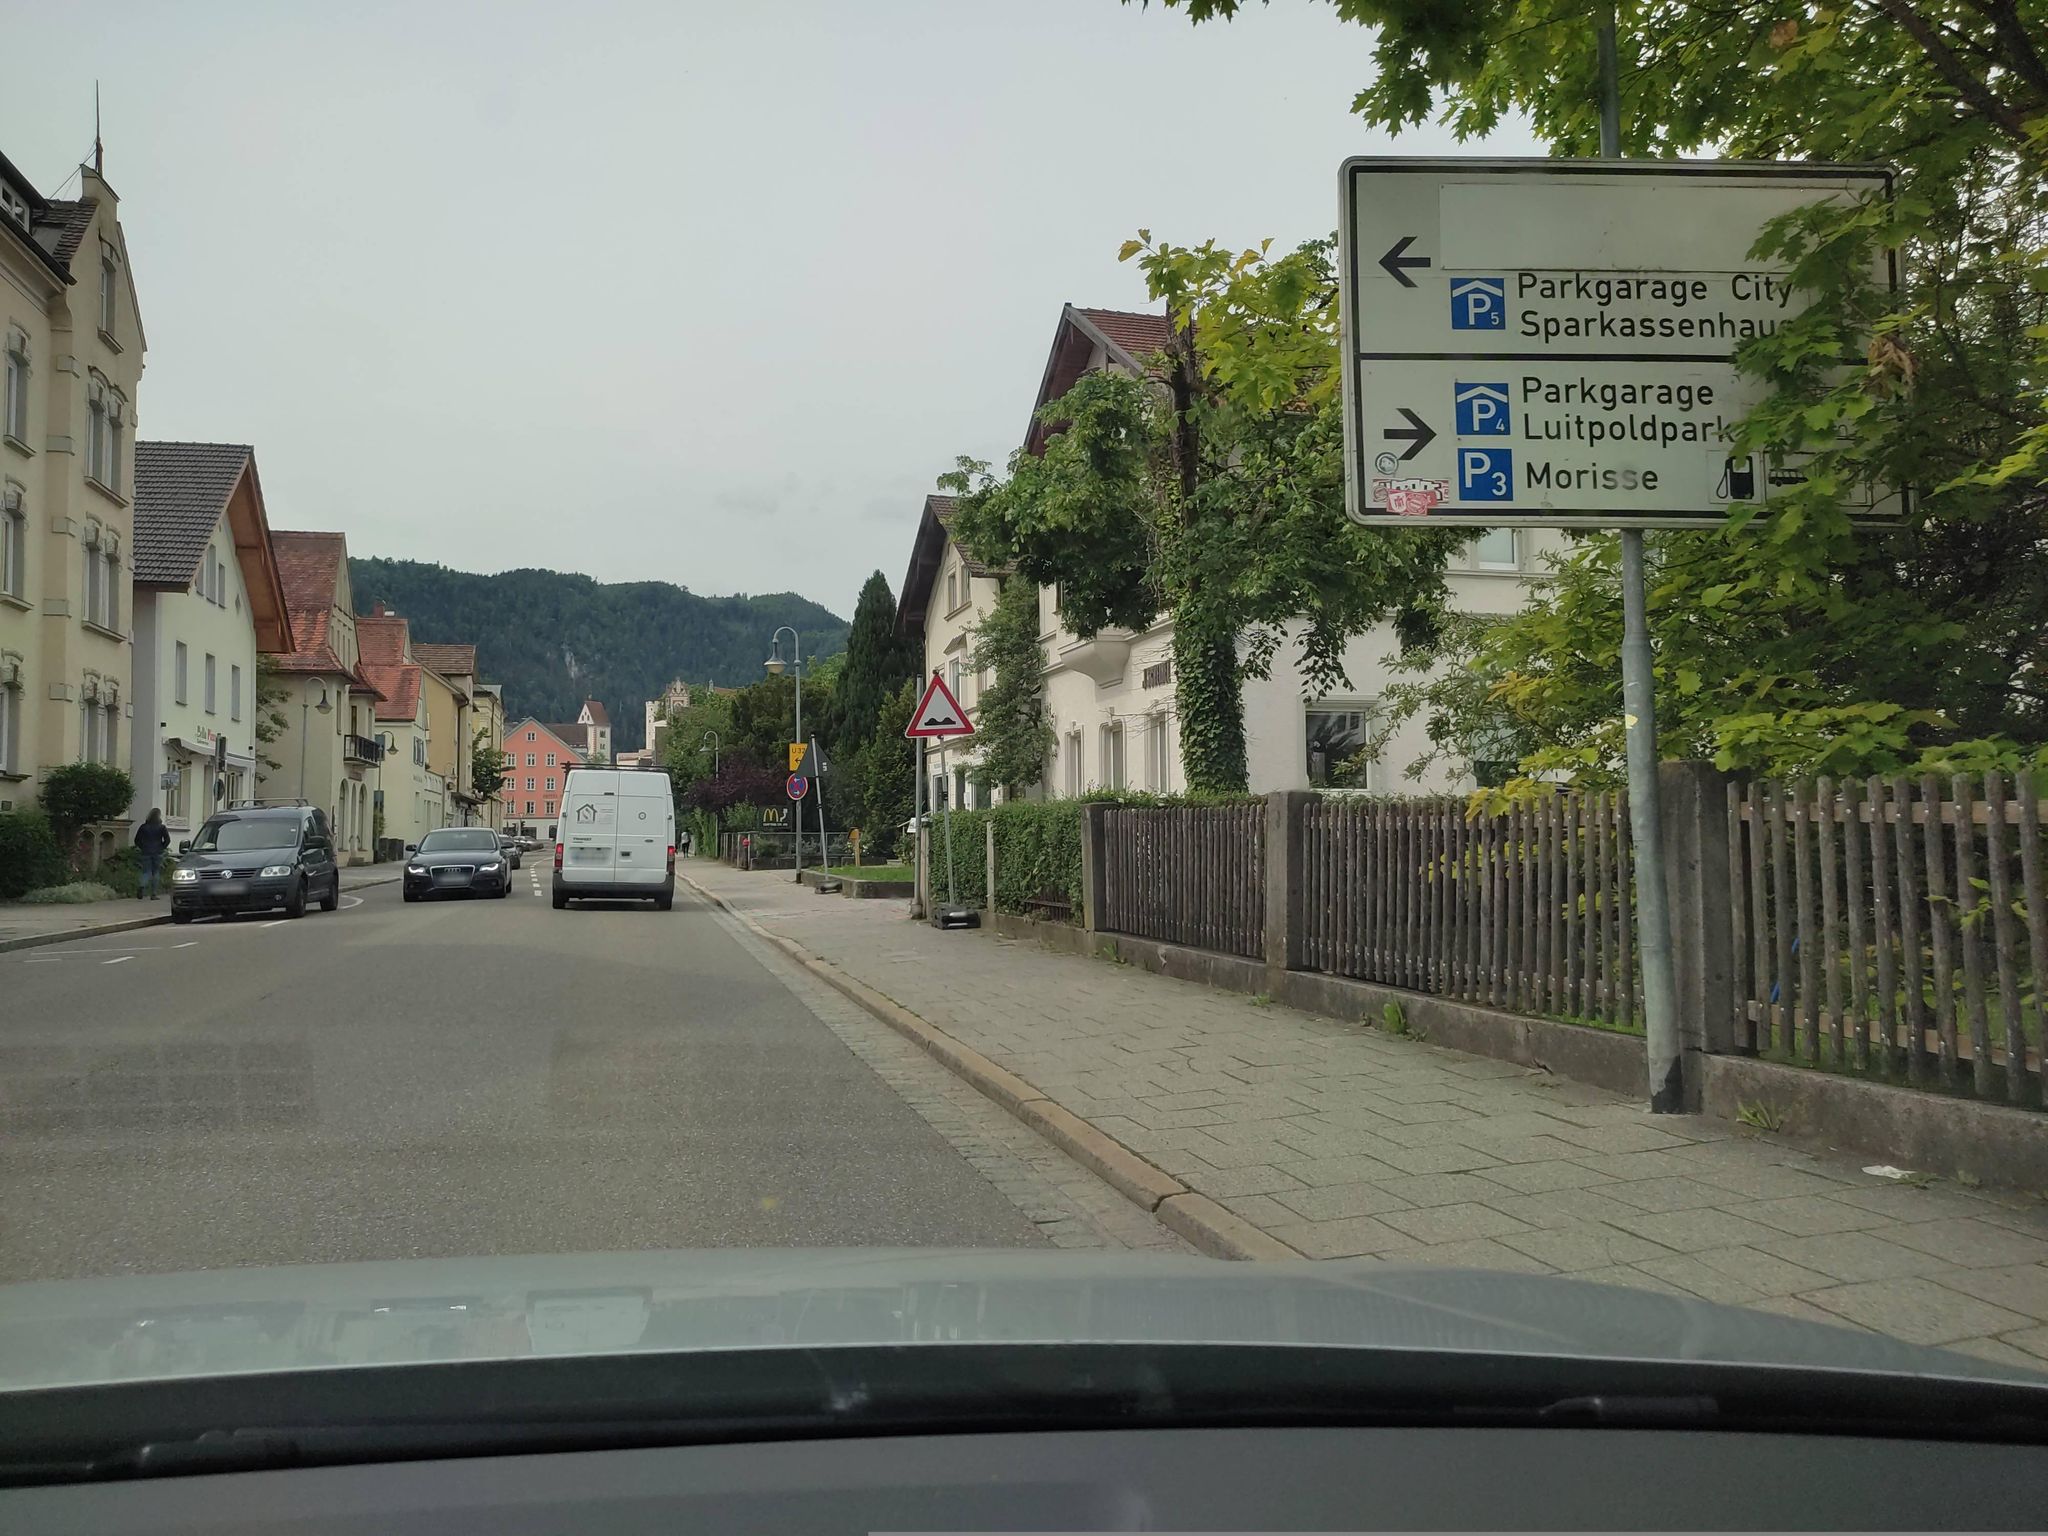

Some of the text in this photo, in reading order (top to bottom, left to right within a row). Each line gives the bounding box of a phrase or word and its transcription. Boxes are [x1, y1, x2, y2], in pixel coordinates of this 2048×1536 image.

[1517, 272, 1794, 309] Parkgarage City
[1522, 377, 1714, 412] Parkgarage
[1523, 413, 1736, 448] Luitpoldpark
[1525, 462, 1659, 491] Morisse
